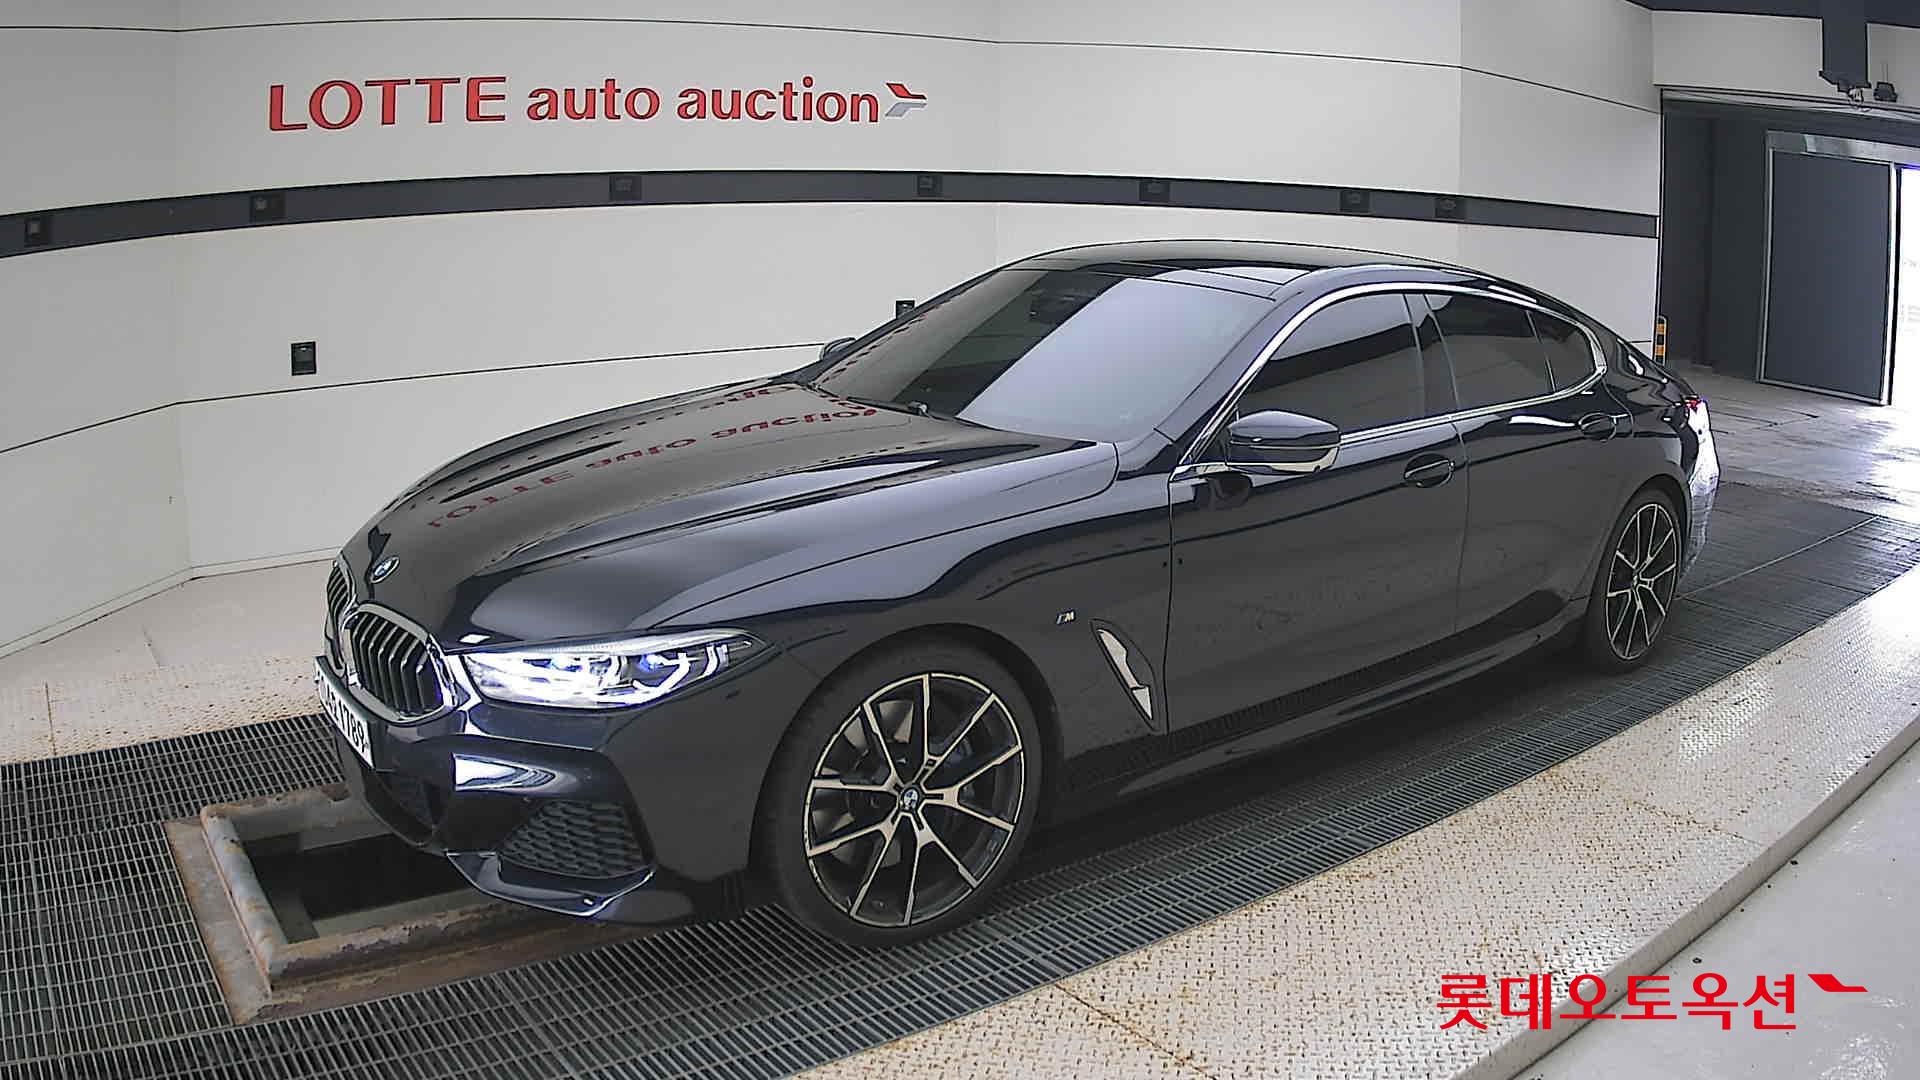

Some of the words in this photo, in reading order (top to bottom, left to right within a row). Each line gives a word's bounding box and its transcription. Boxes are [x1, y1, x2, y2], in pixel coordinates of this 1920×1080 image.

[269, 76, 506, 132] LOTTE
[527, 78, 661, 121] auto
[676, 75, 880, 123] auction
